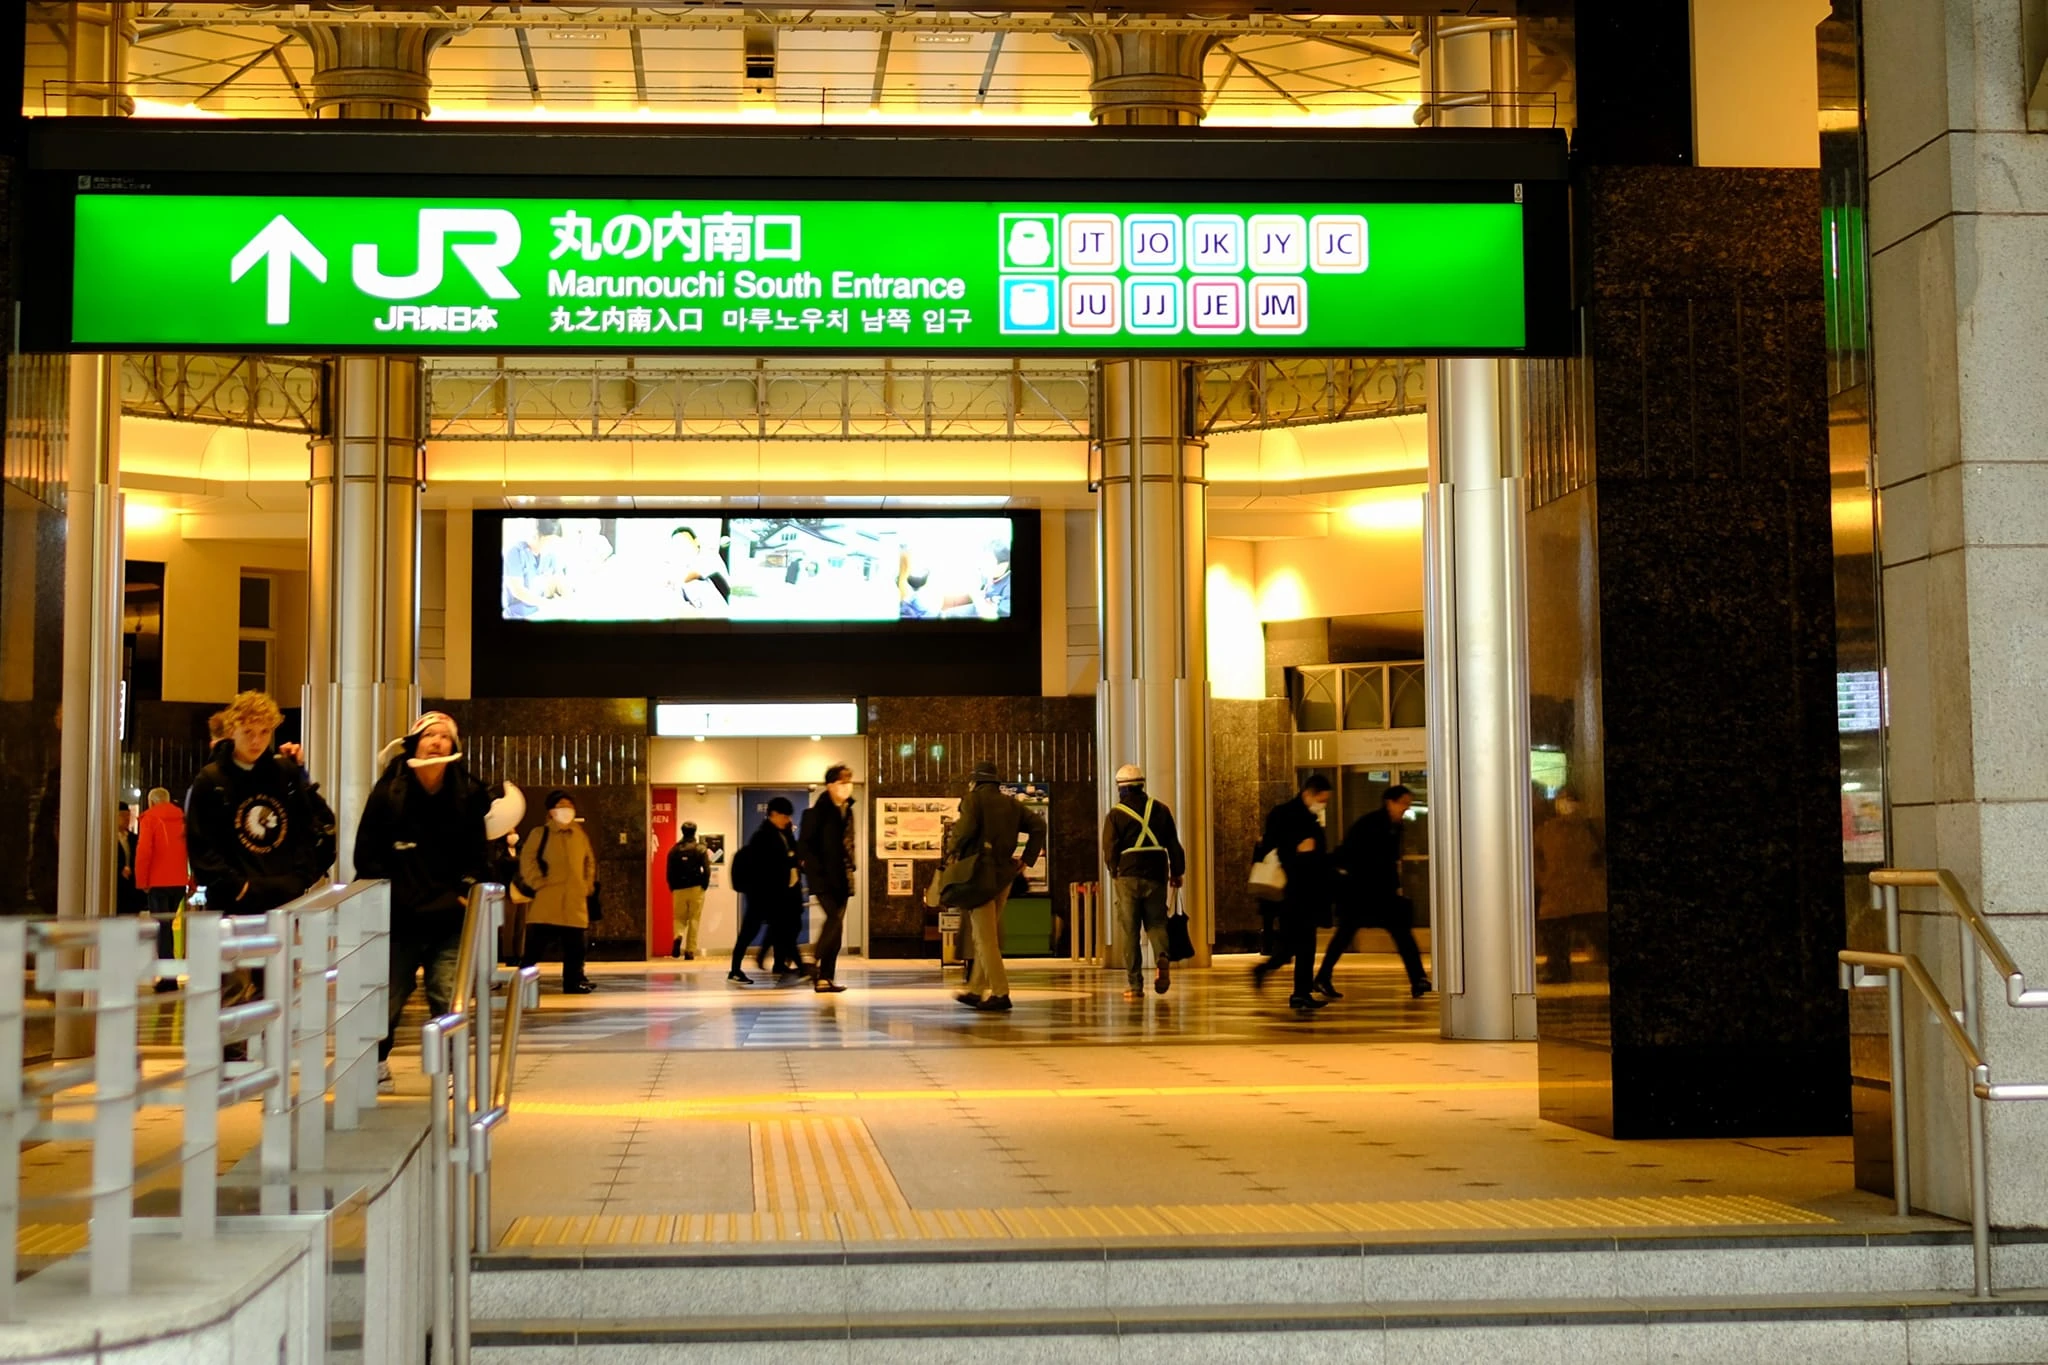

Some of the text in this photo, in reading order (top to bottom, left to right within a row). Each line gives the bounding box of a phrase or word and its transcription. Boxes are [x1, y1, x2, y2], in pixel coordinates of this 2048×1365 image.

[549, 210, 802, 263] 丸の内南口
[1078, 232, 1353, 255] JT JO JK JY JC
[352, 208, 521, 299] JR
[548, 269, 966, 300] Marunouchi South Entrance
[373, 304, 498, 332] JR東日本
[549, 305, 703, 333] 丸之内南入口
[1076, 294, 1295, 316] JU JJ JE JM
[722, 307, 973, 334] 마루노우치 남쪽 입구
